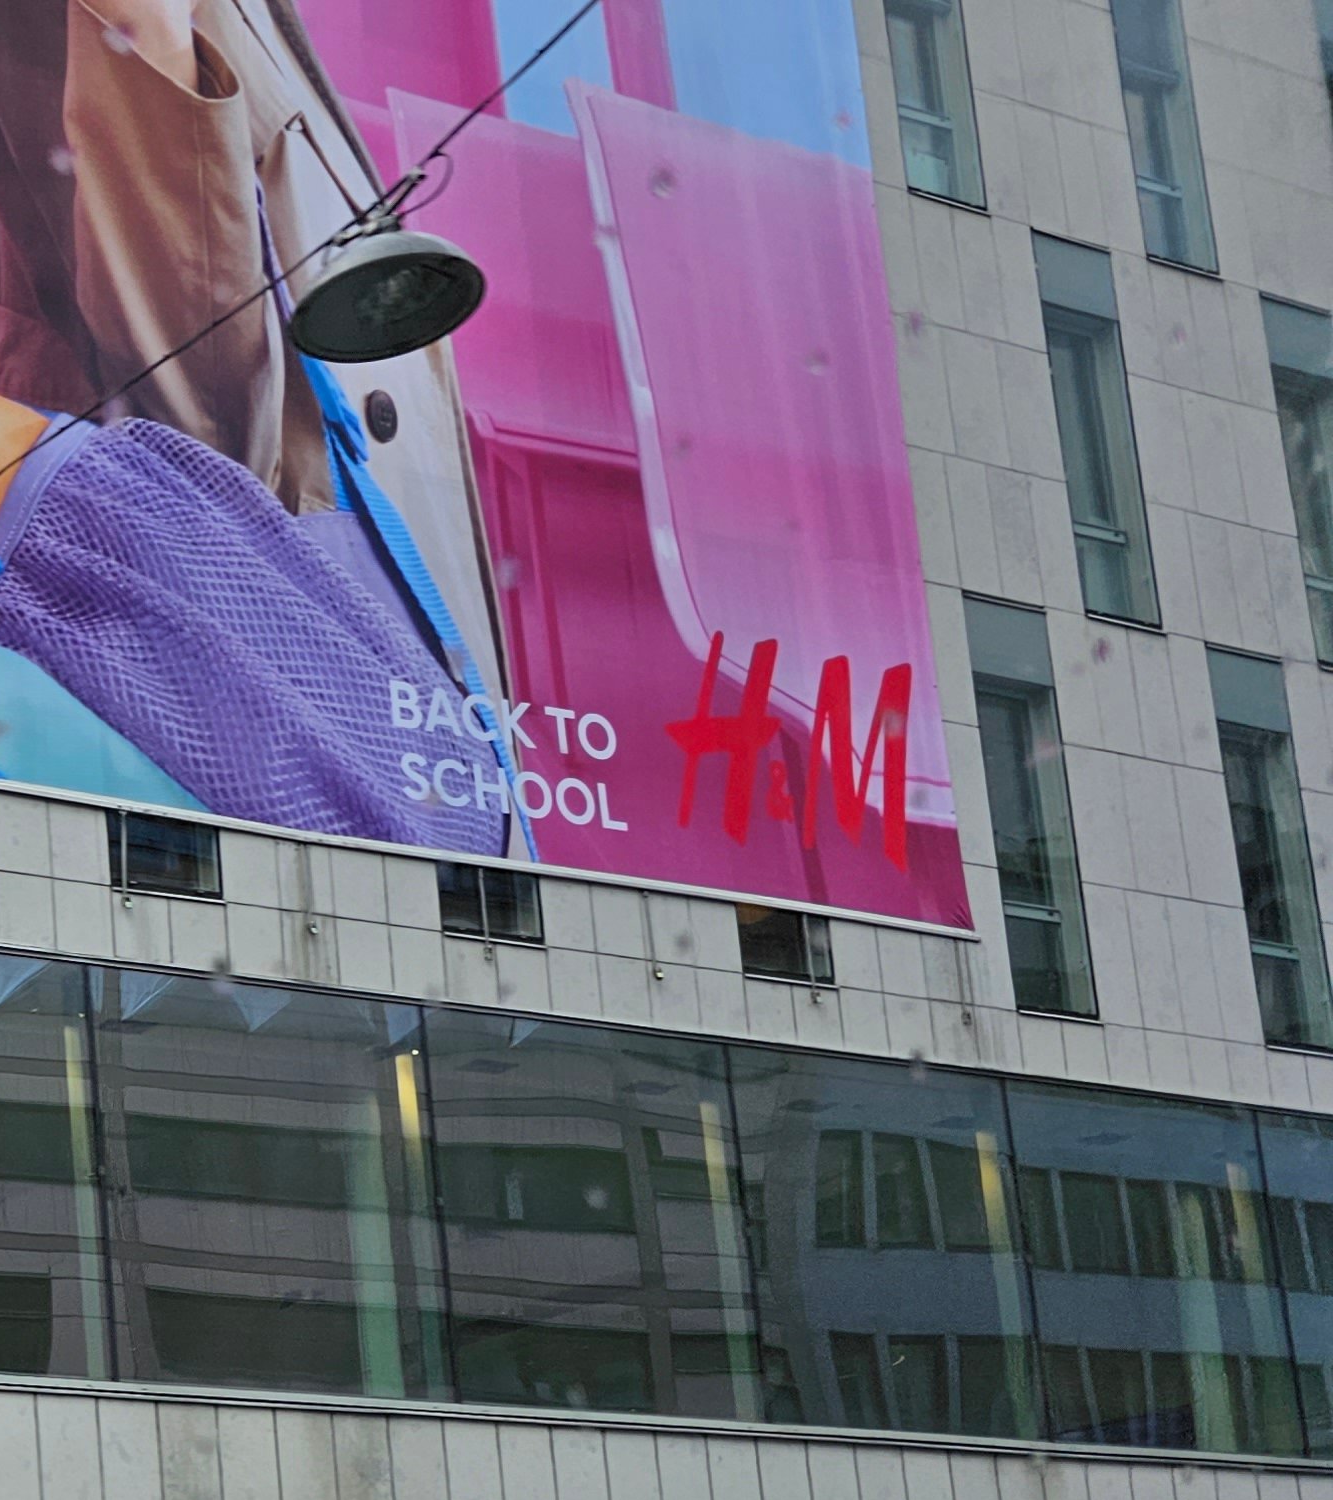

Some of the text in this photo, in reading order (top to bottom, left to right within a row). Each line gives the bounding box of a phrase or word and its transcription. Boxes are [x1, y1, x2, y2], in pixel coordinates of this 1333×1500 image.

[390, 680, 617, 760] BACK TO
[666, 631, 912, 873] H&M
[401, 753, 628, 832] SCHOOL
